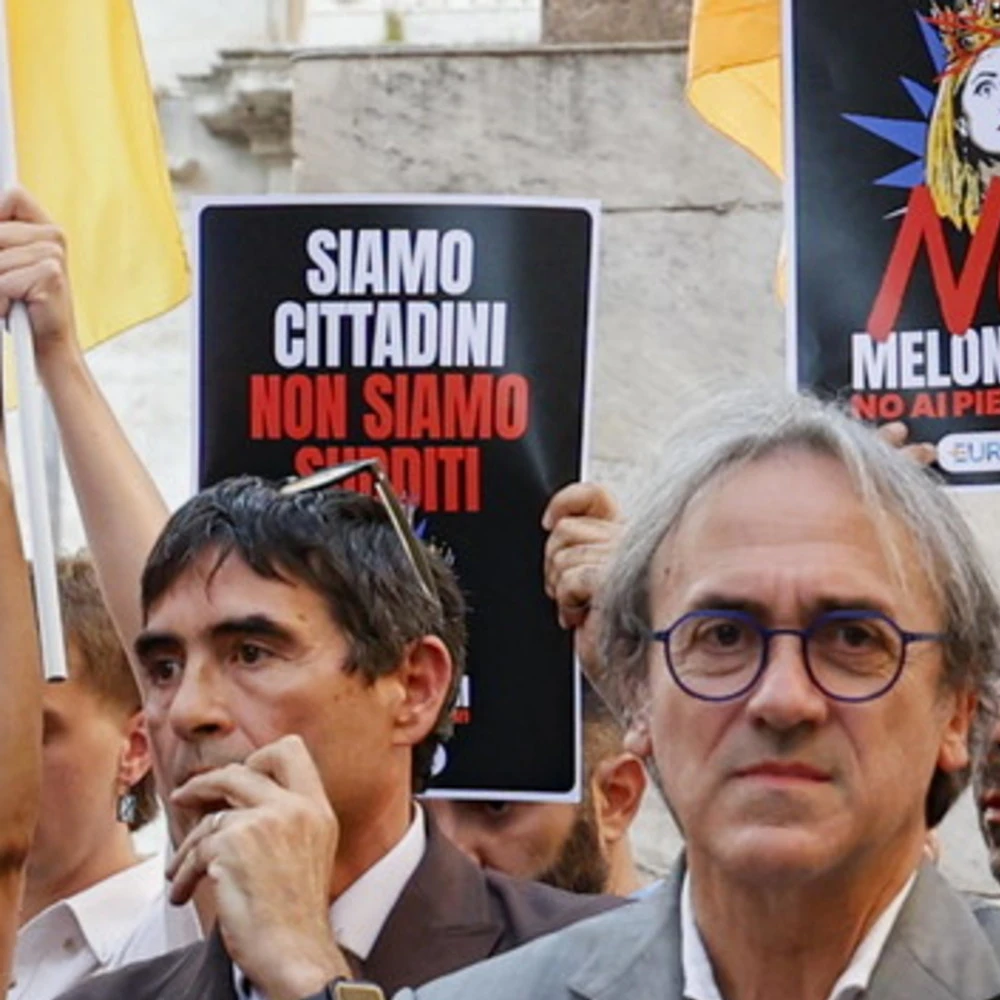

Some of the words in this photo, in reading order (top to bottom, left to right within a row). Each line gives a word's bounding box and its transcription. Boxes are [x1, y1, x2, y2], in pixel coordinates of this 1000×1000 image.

[305, 228, 473, 295] SIAMO
[273, 301, 508, 368] CITTADINI
[249, 374, 347, 441] NON
[362, 374, 530, 441] SIAMO
[851, 392, 905, 421] NO
[910, 390, 948, 419] AI
